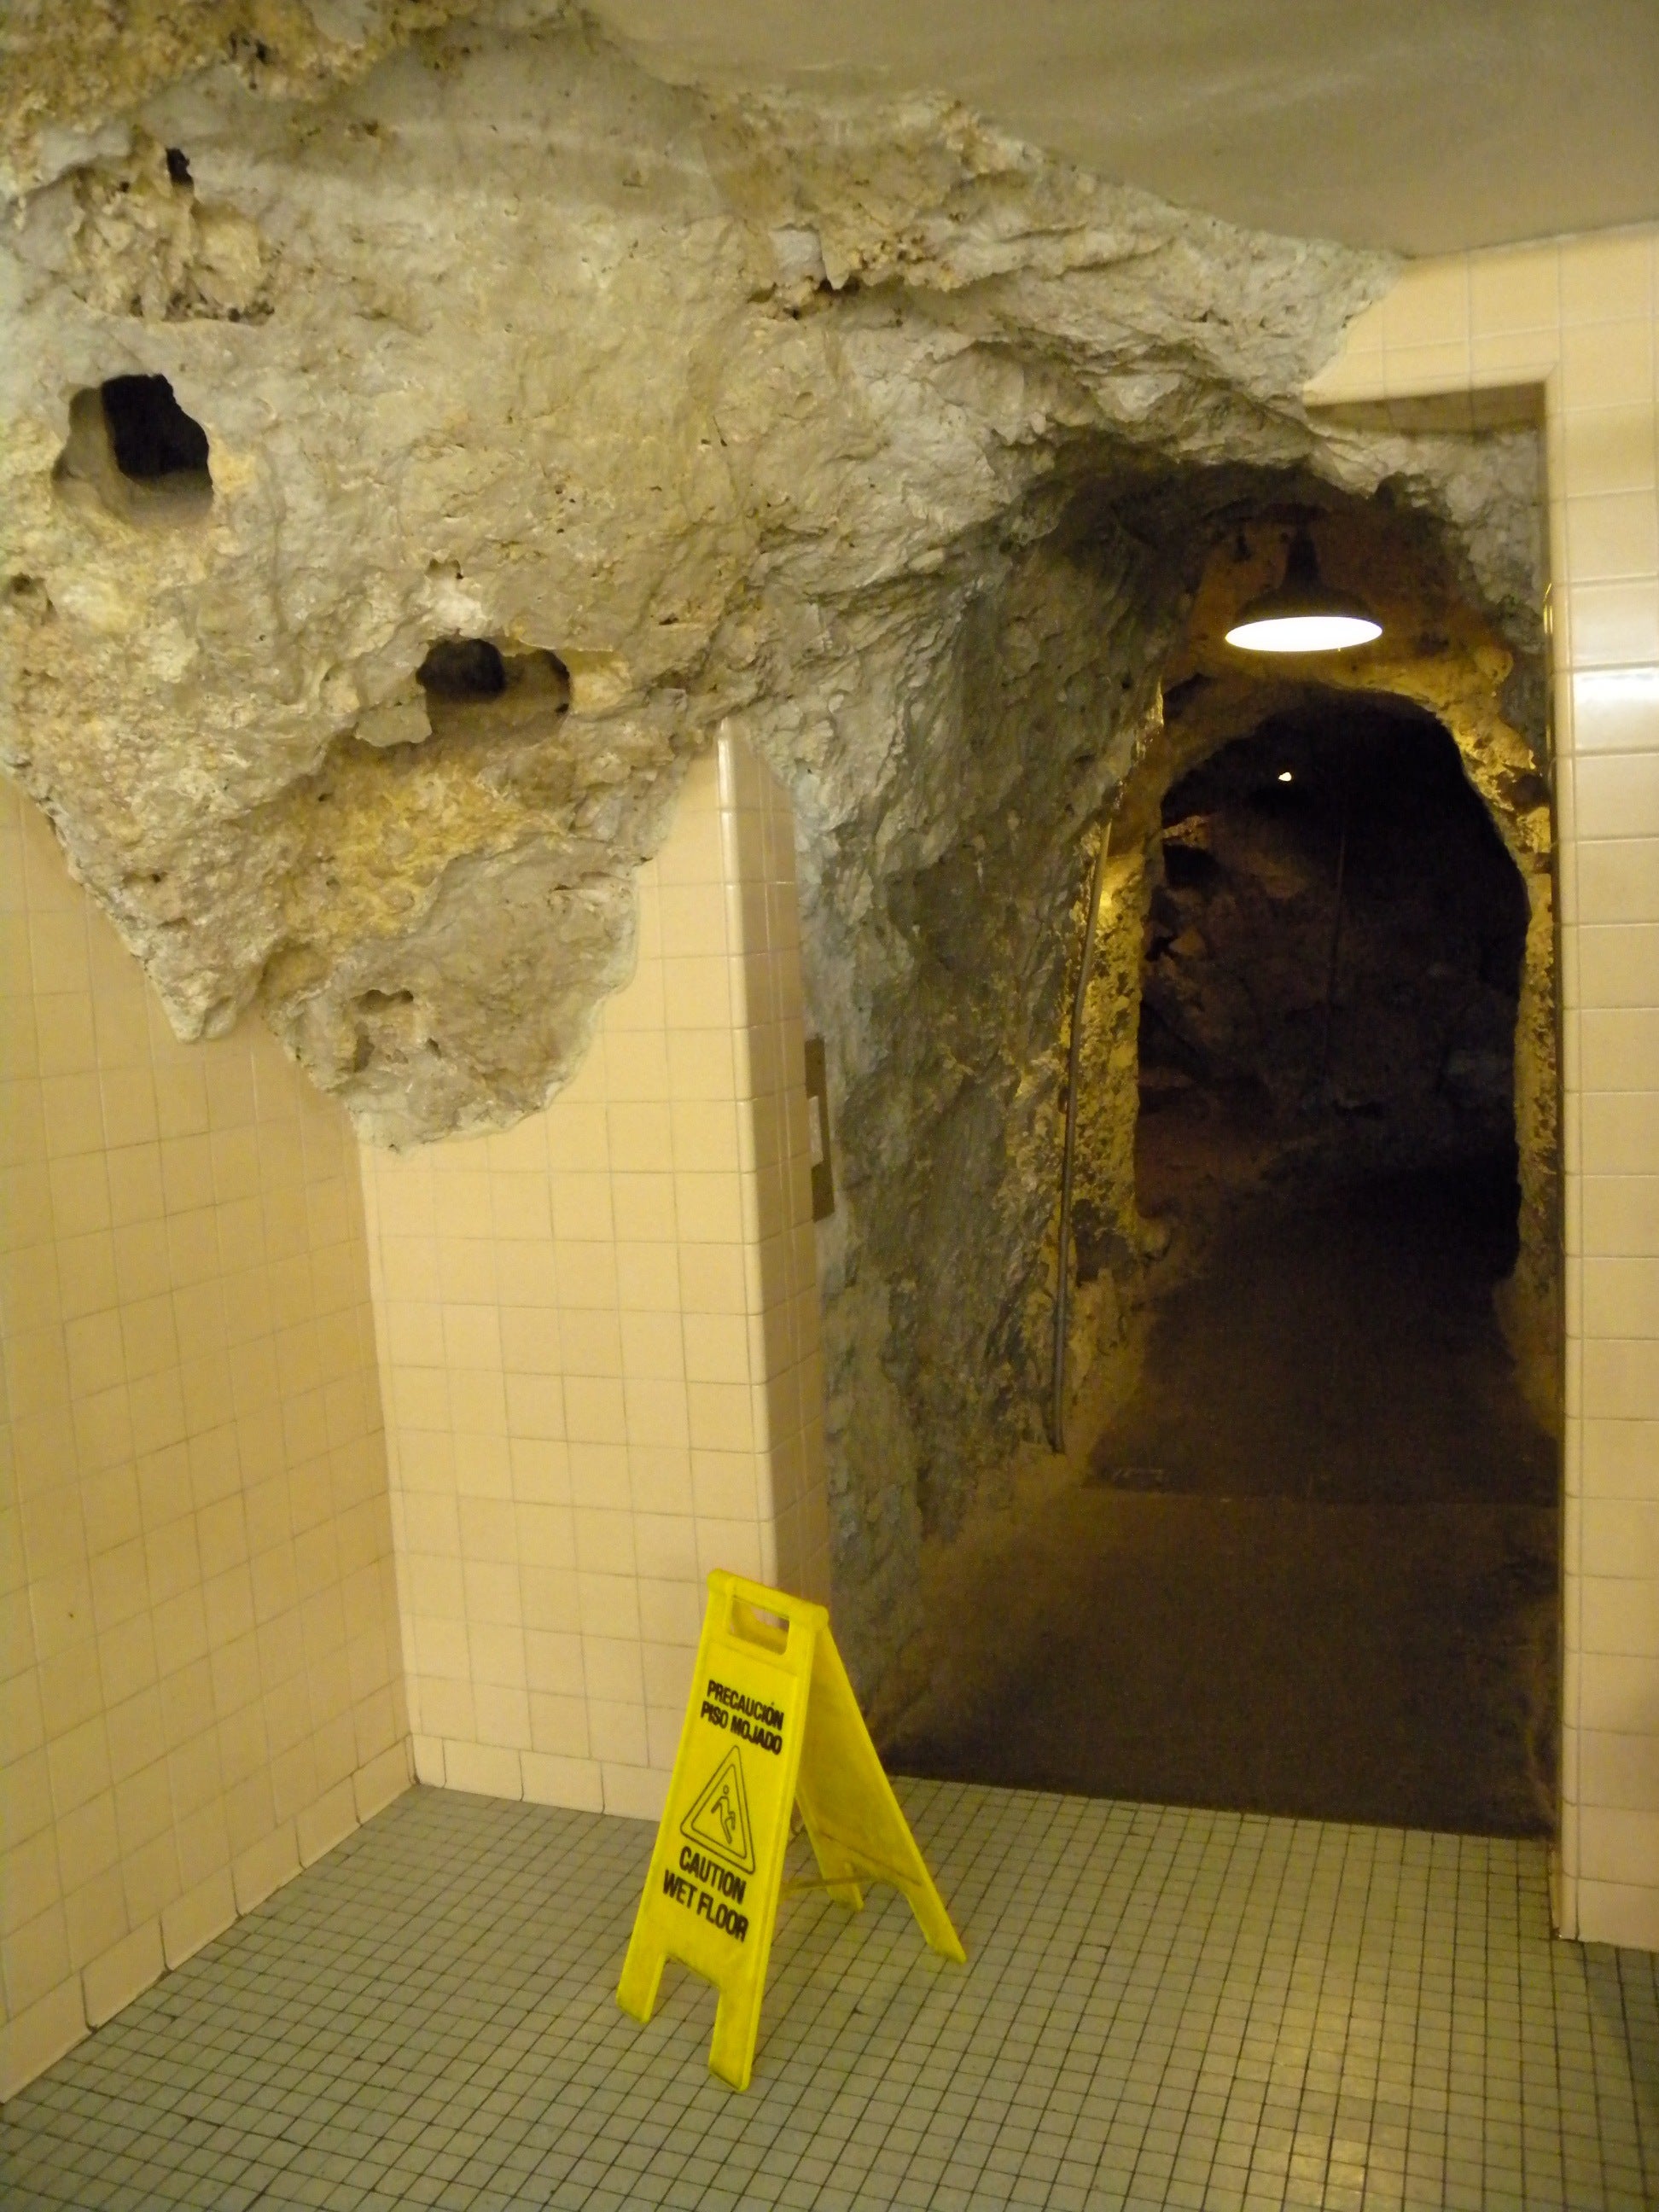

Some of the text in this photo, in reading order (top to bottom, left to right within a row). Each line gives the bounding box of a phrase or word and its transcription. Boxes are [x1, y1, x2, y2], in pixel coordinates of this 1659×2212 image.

[701, 1700, 783, 1755] PISO MOJADO
[707, 1679, 784, 1731] PRECAUCIÓN
[679, 1846, 747, 1905] CAUTION
[663, 1869, 749, 1943] WET FLOOR
